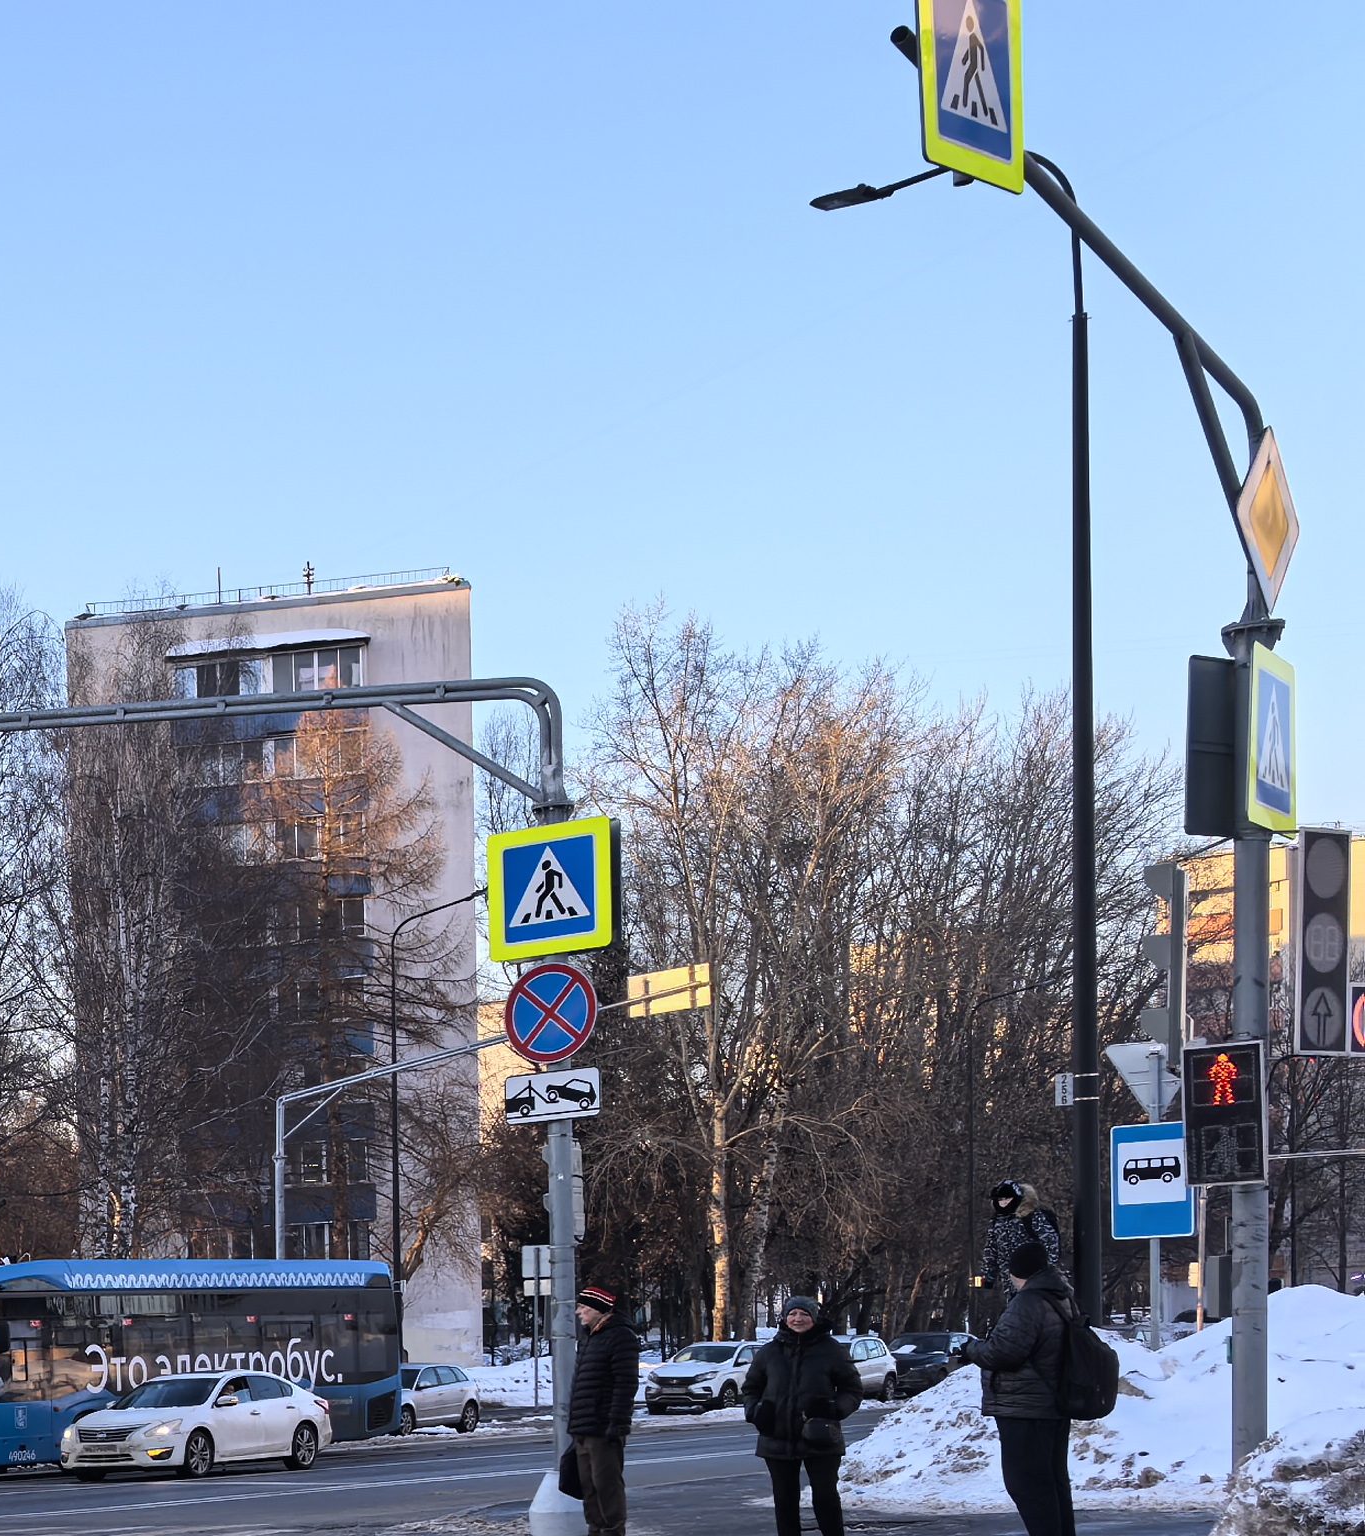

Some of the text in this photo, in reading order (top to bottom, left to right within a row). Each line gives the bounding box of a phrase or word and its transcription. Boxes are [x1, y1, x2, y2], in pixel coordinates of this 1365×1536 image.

[1060, 1074, 1068, 1105] 256
[84, 1344, 148, 1394] Это
[8, 1449, 37, 1462] 490246
